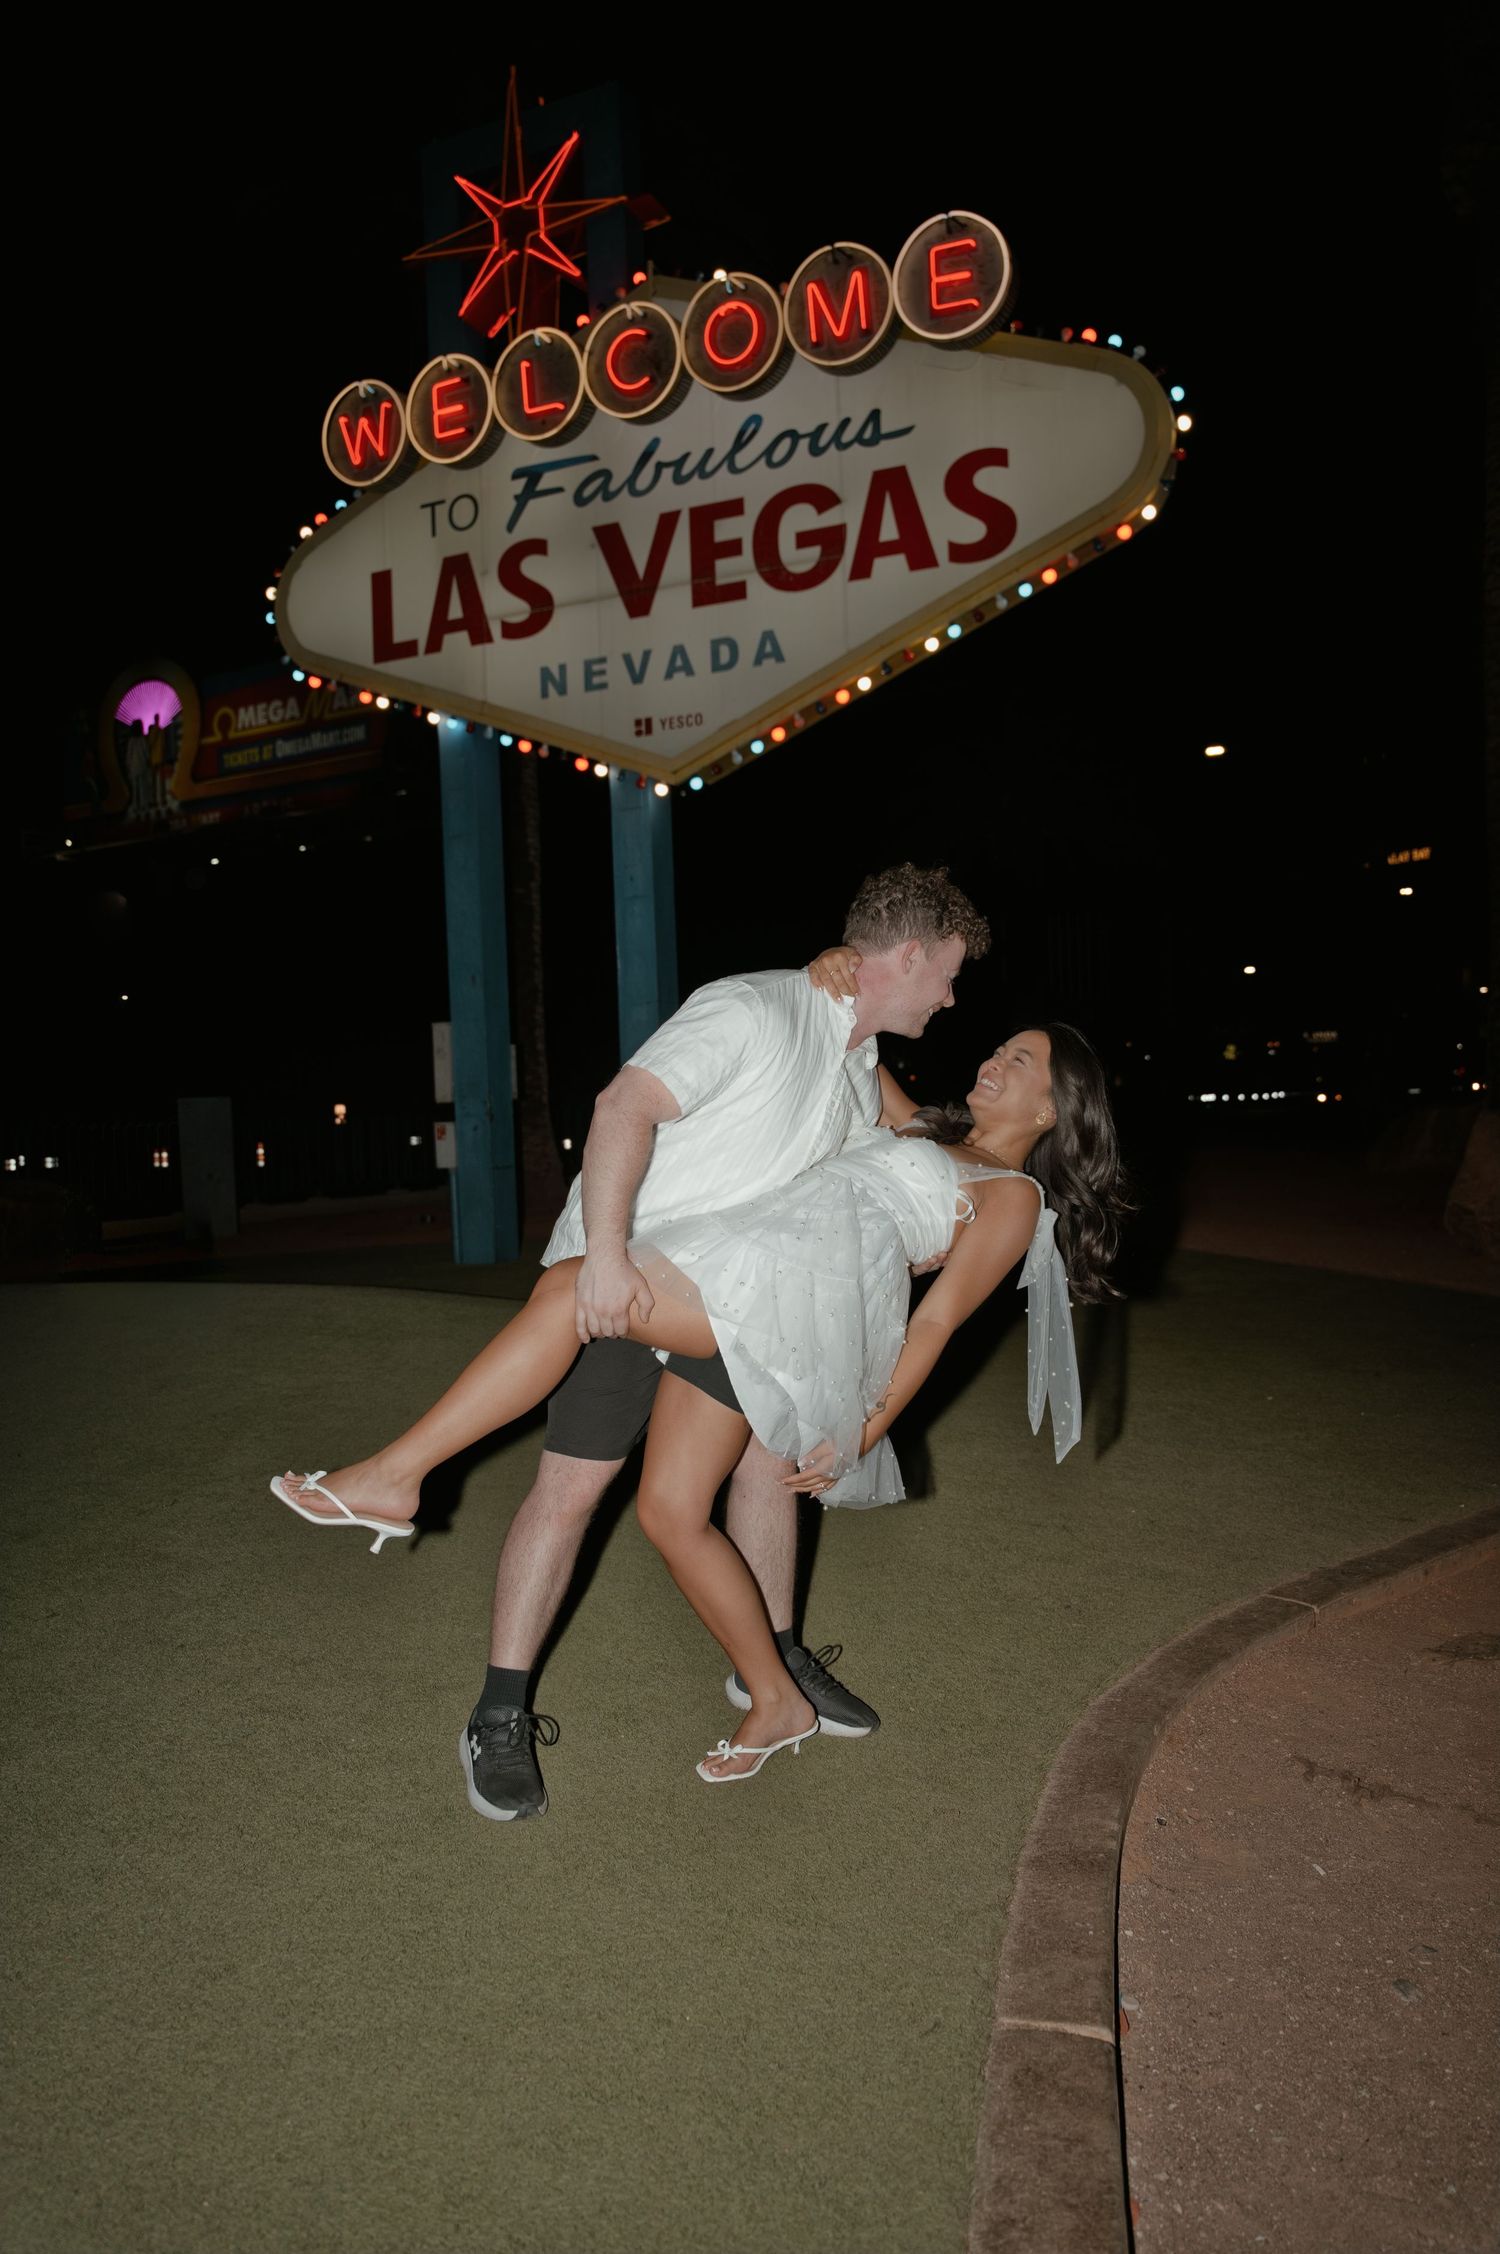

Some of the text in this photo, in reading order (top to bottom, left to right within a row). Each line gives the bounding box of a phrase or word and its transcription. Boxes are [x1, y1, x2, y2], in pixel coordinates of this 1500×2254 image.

[339, 234, 980, 466] WELCOME
[420, 408, 916, 538] TO Fabulous
[371, 447, 1018, 665] LAS VEGAS
[539, 630, 785, 700] NEVADA
[659, 713, 704, 733] YESCO
